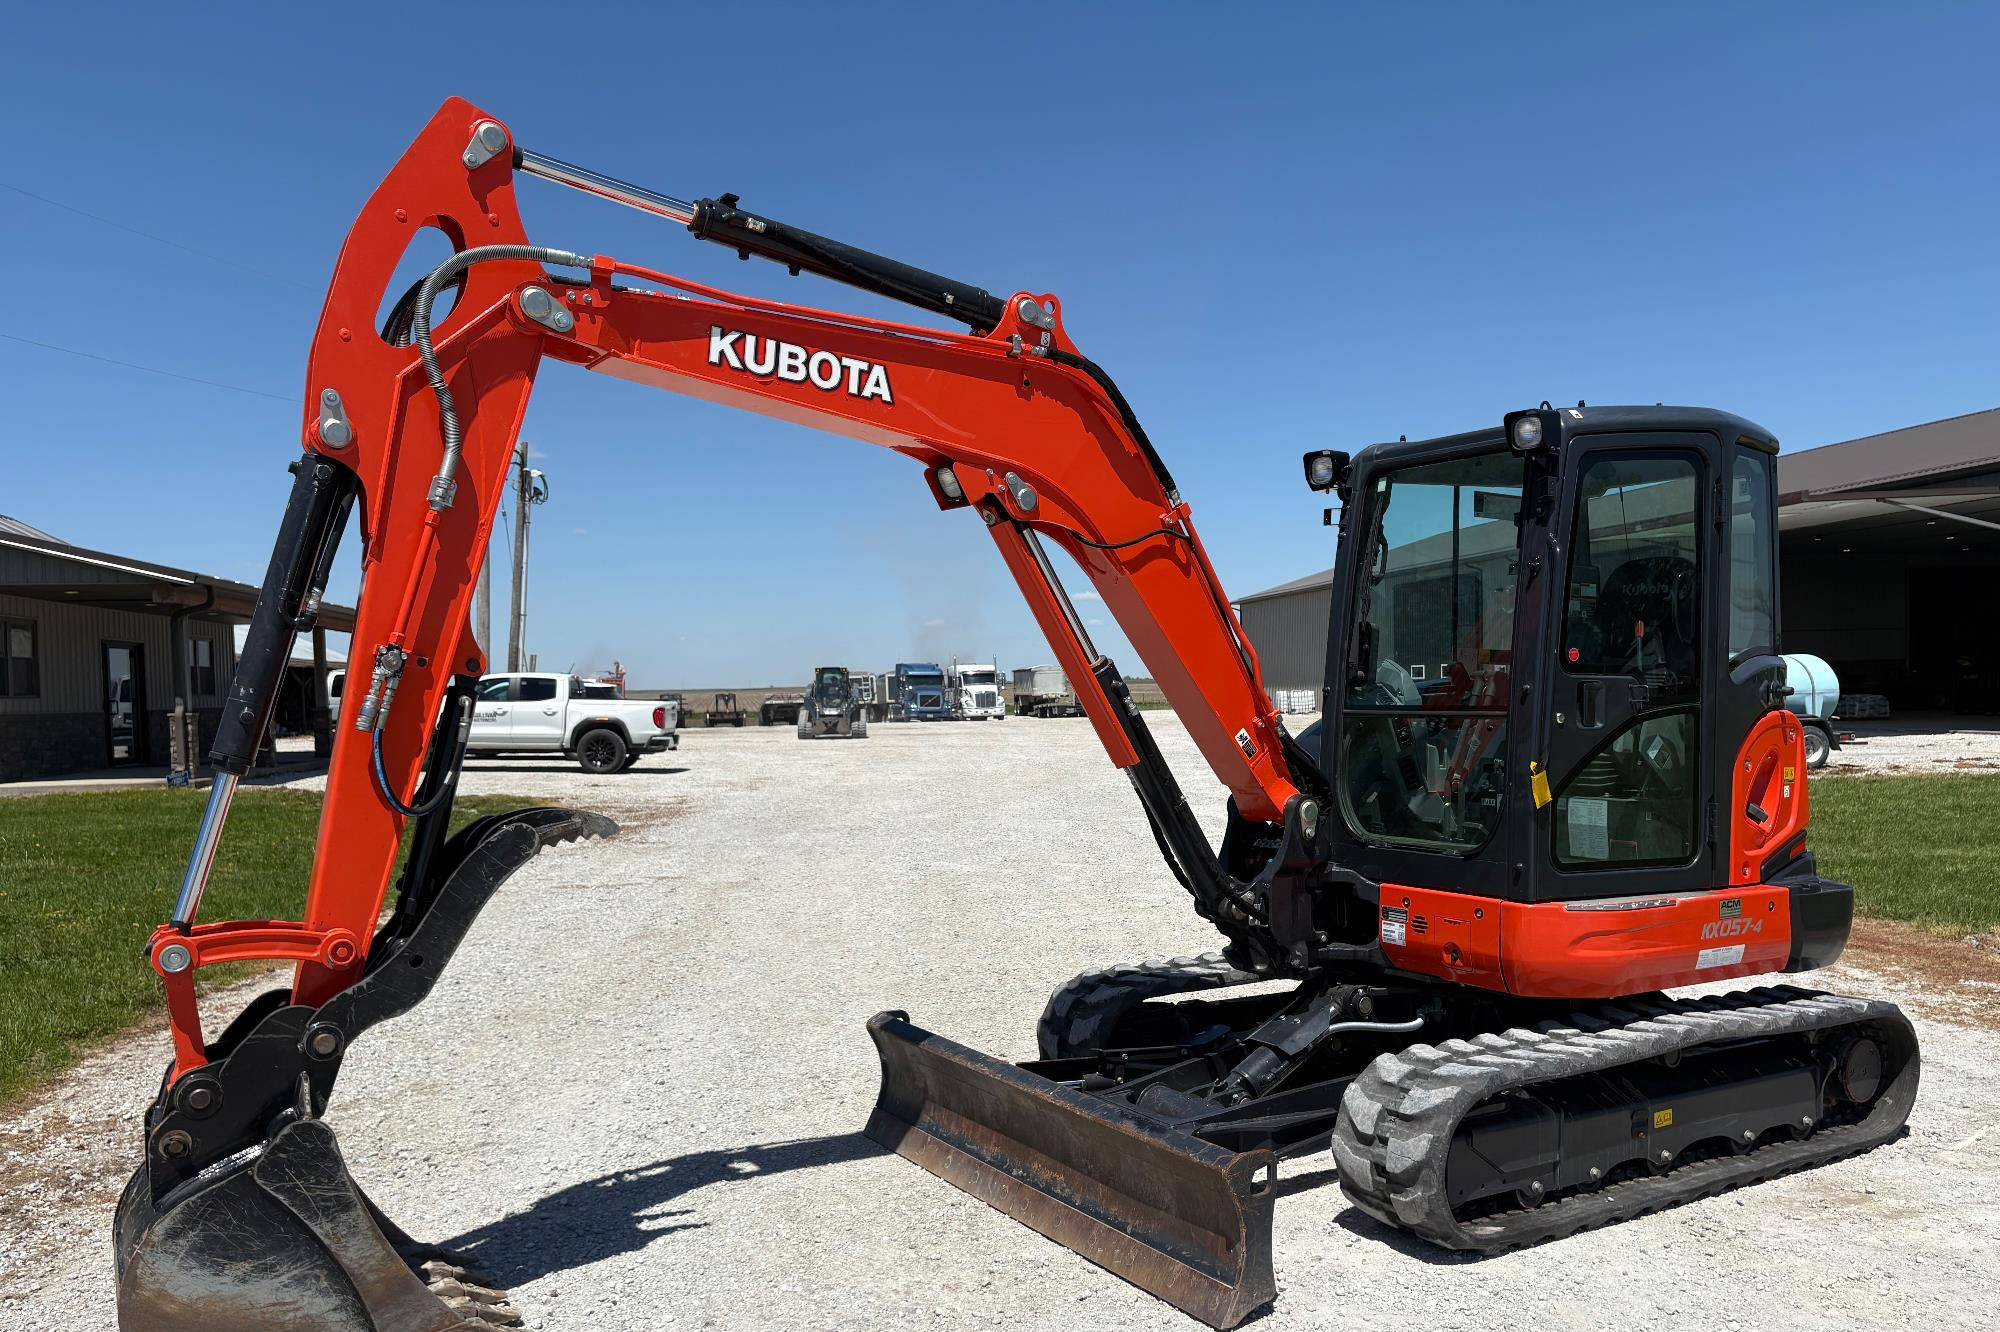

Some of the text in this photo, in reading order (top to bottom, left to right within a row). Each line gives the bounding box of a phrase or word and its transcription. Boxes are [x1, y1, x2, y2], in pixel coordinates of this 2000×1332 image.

[708, 325, 893, 403] KUBOTA
[1721, 899, 1741, 909] ACM
[1701, 917, 1763, 940] KX057-4
